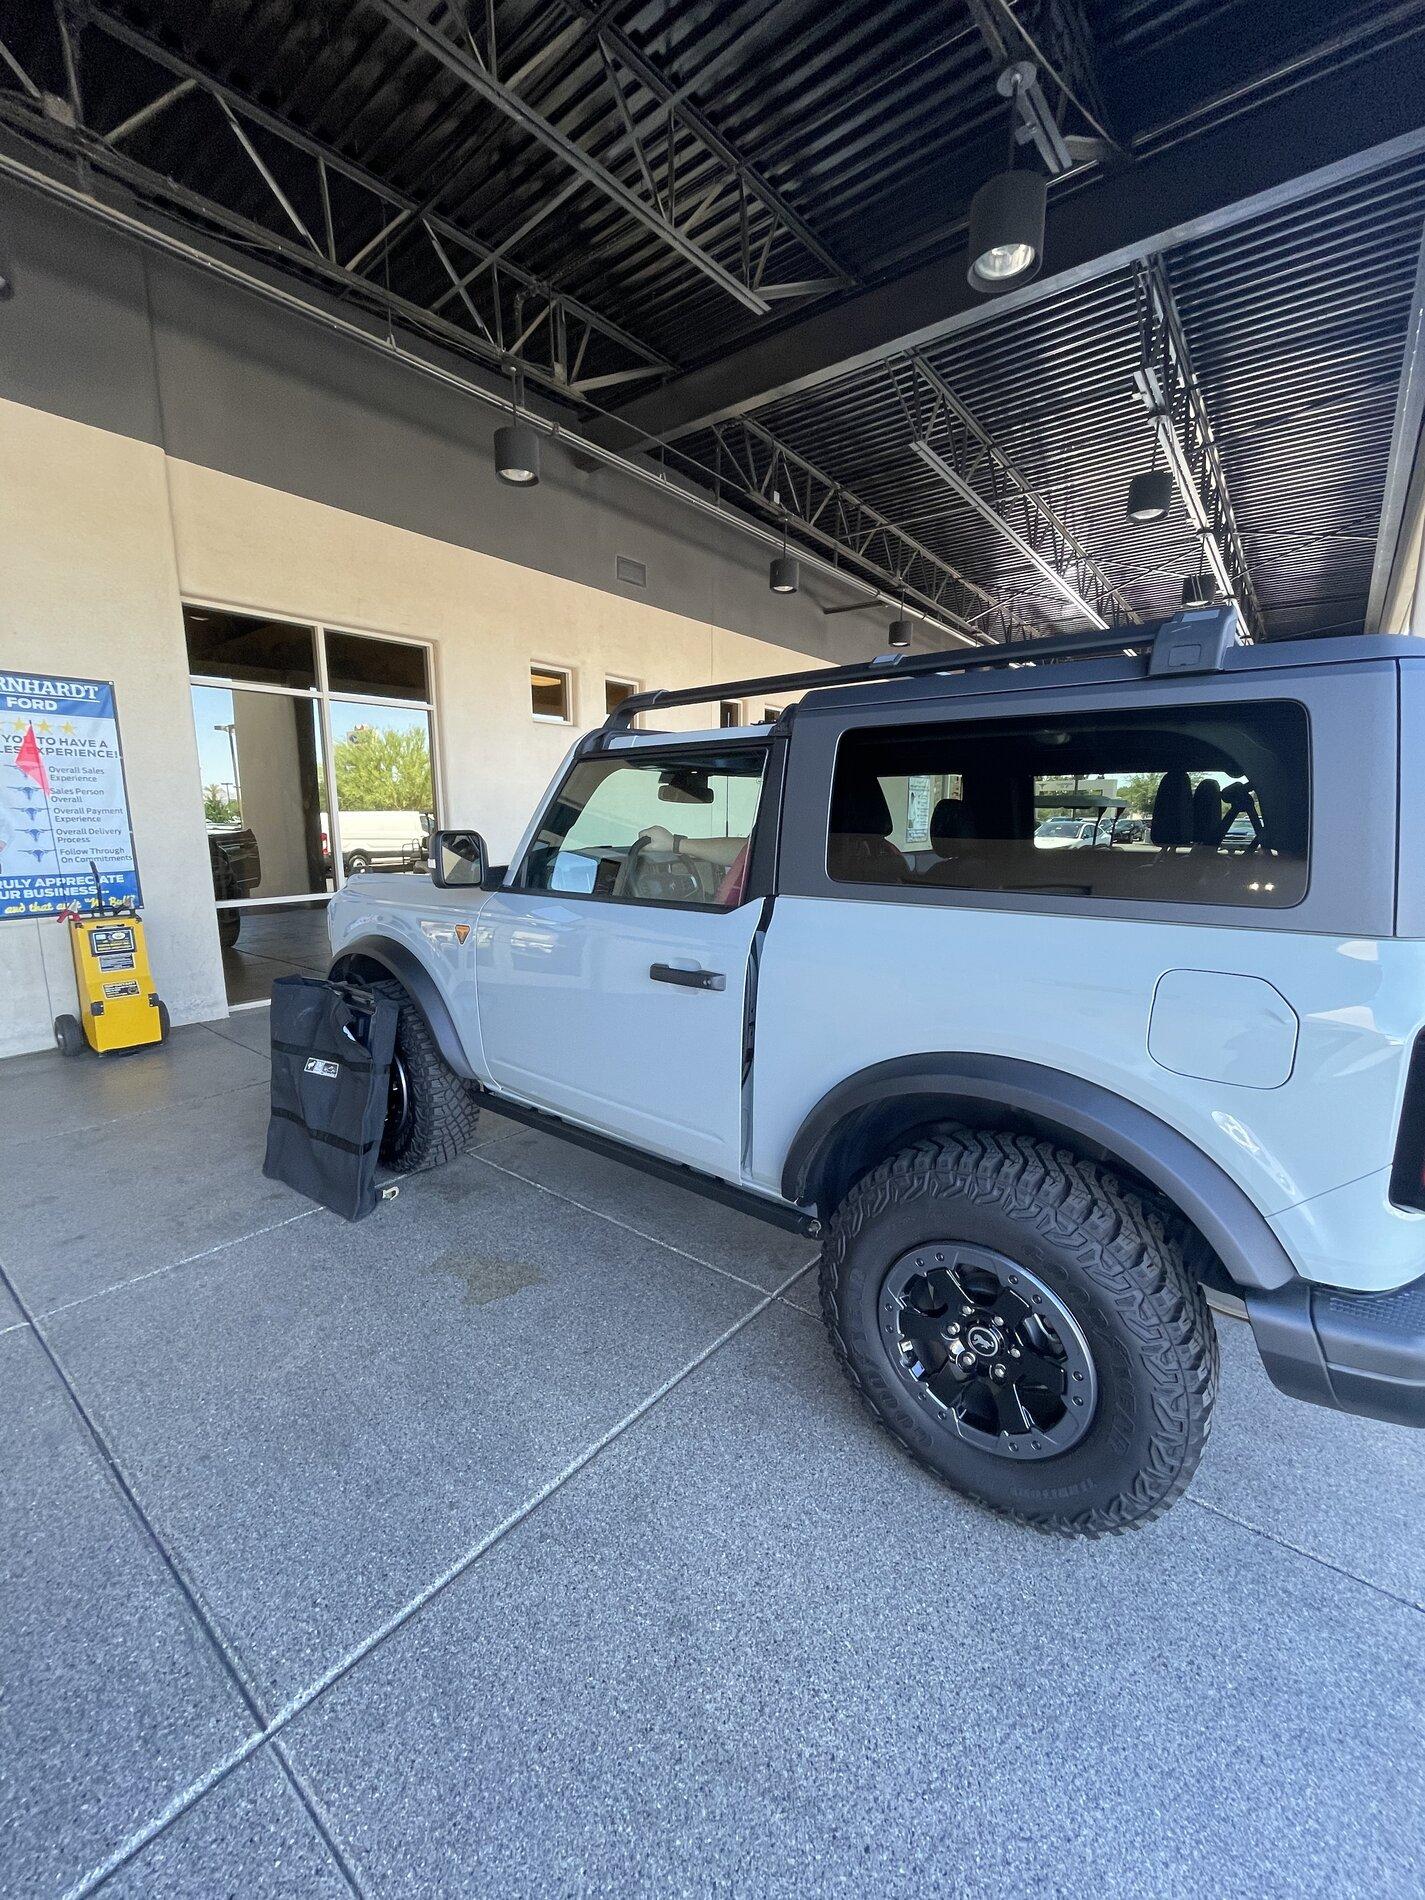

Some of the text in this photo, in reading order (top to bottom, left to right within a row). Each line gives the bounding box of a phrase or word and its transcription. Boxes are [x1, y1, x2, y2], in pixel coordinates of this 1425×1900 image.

[7, 697, 57, 711] FORD
[2, 734, 108, 748] YO TO HAVE A
[0, 745, 23, 755] ES
[49, 766, 105, 775] Overall Sales
[50, 774, 98, 783] Experience
[50, 787, 74, 795] Sales
[53, 807, 124, 816] Overall Payment
[89, 828, 122, 836] Delivery
[90, 847, 125, 855] Through
[61, 855, 133, 864] On Commitments
[35, 875, 124, 887] APPRECATE
[4, 903, 26, 913] and
[29, 902, 54, 912] that
